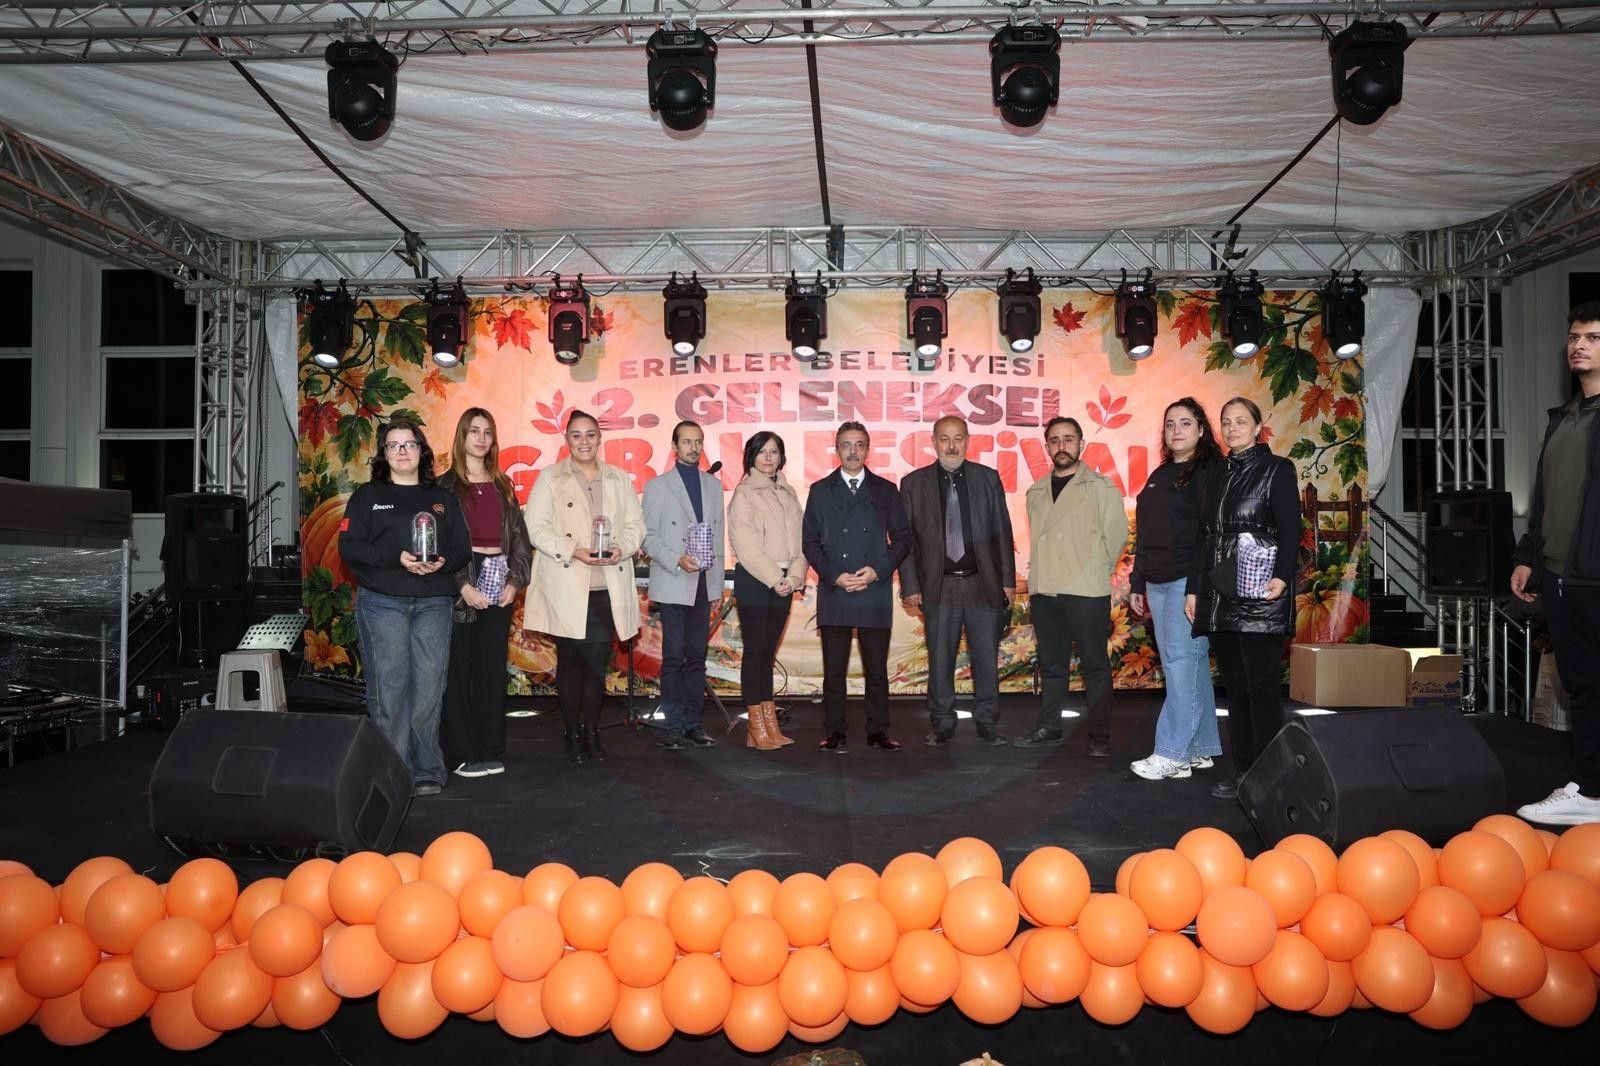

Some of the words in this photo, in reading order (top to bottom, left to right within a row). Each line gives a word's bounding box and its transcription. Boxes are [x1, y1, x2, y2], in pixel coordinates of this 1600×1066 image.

[619, 352, 792, 380] ERENLER
[810, 347, 1045, 378] BELEDİYESİ
[590, 387, 661, 432] 2.
